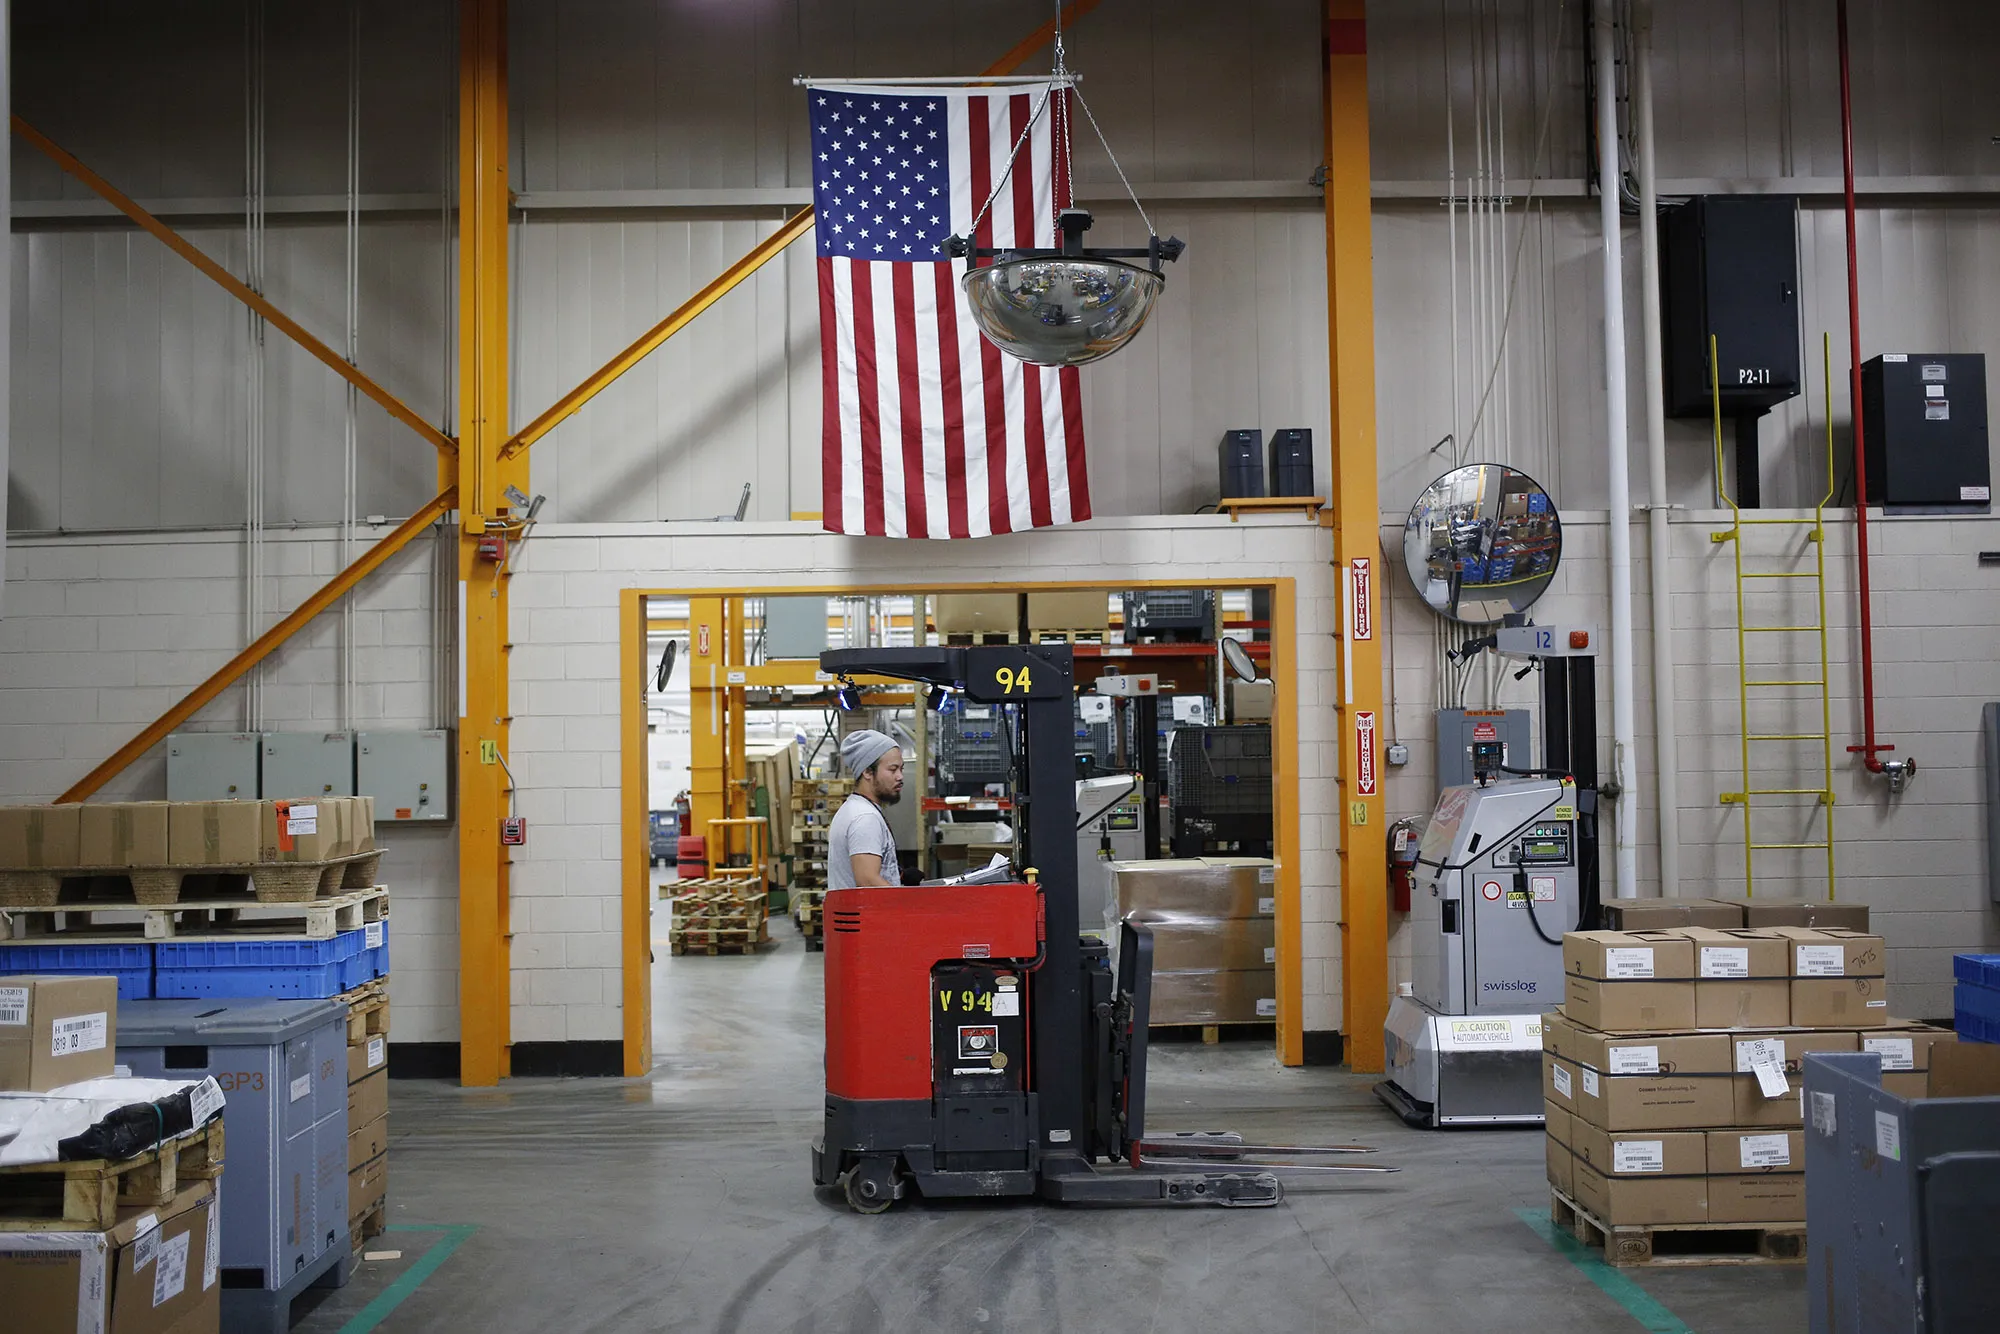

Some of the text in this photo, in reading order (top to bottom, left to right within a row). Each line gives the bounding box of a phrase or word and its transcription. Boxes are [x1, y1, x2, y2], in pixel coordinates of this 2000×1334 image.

[1739, 368, 1769, 384] P2-11
[1536, 631, 1551, 648] 12
[995, 666, 1032, 694] 94
[1121, 679, 1126, 689] 3
[1358, 719, 1372, 728] FIRE
[481, 741, 495, 762] 14
[1483, 980, 1537, 993] swisslog
[940, 990, 992, 1012] V 94
[1469, 1022, 1506, 1032] CAUTION
[1456, 1032, 1510, 1042] AUTOMATIC VEHICLE
[217, 1071, 265, 1092] GP3
[1622, 1242, 1645, 1254] EPAL
